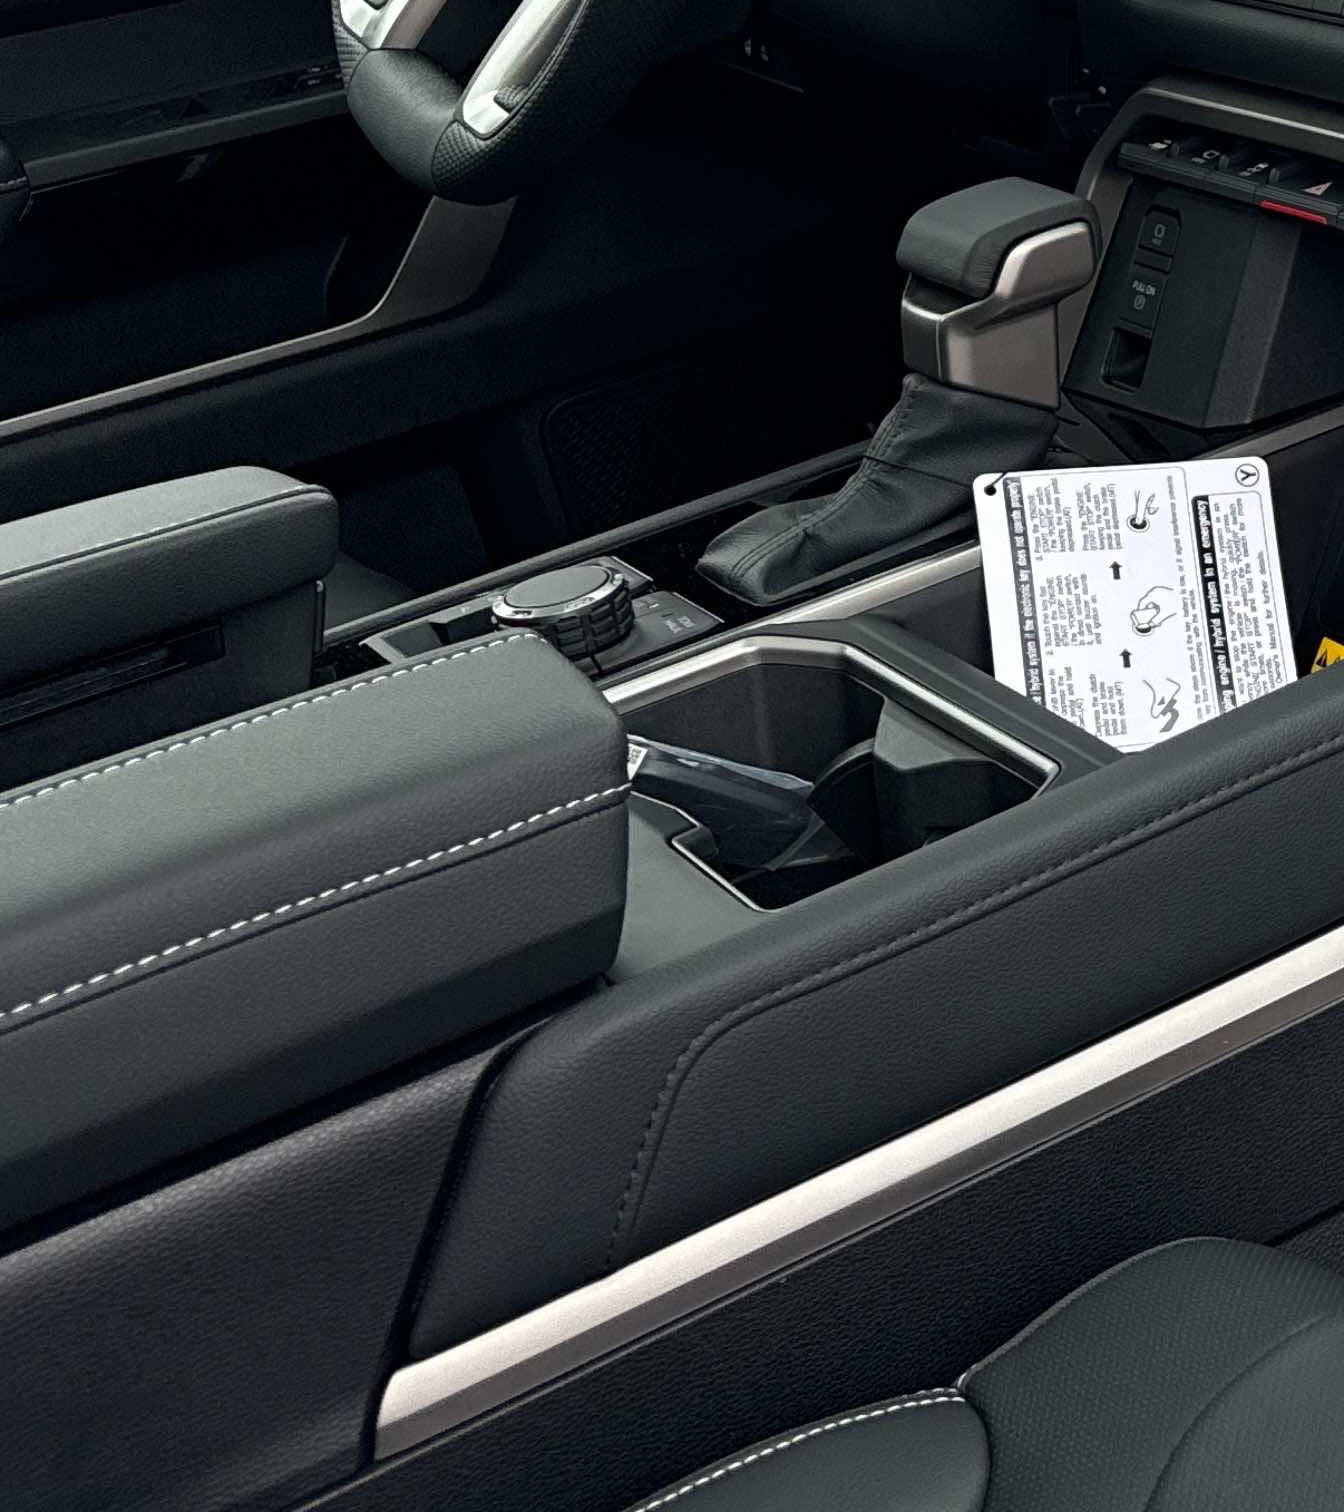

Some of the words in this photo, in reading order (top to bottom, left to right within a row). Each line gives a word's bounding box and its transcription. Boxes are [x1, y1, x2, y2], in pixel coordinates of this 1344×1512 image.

[1238, 468, 1257, 482] Y
[1194, 498, 1214, 549] emergency
[1013, 535, 1025, 547] not
[1015, 548, 1028, 566] does
[1205, 581, 1223, 613] system
[1208, 617, 1227, 647] hybrid
[1215, 653, 1233, 685] engine
